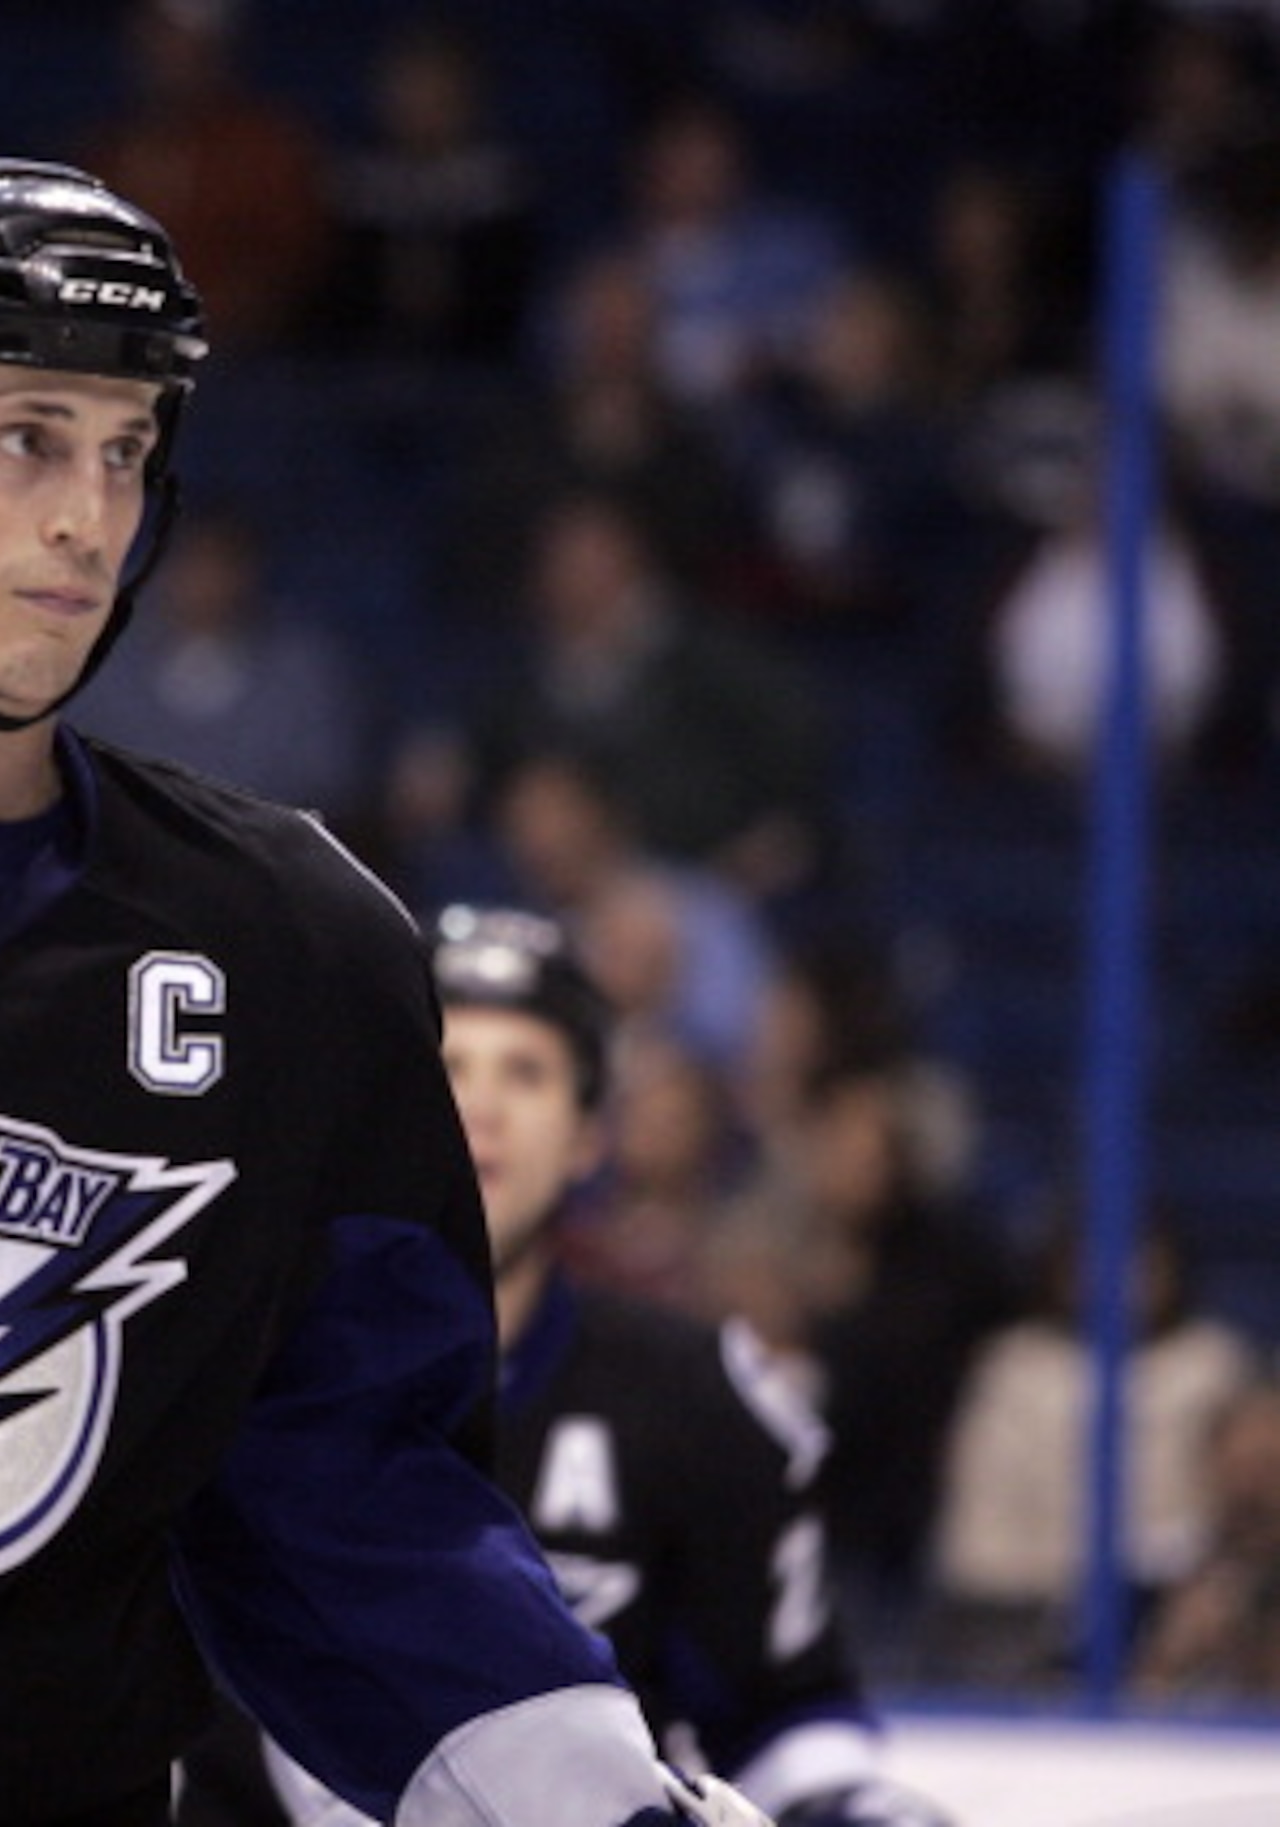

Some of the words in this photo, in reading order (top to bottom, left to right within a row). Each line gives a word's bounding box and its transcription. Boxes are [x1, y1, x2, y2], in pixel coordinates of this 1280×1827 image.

[59, 278, 166, 313] CCM
[127, 950, 227, 1097] C
[533, 1414, 620, 1532] A
